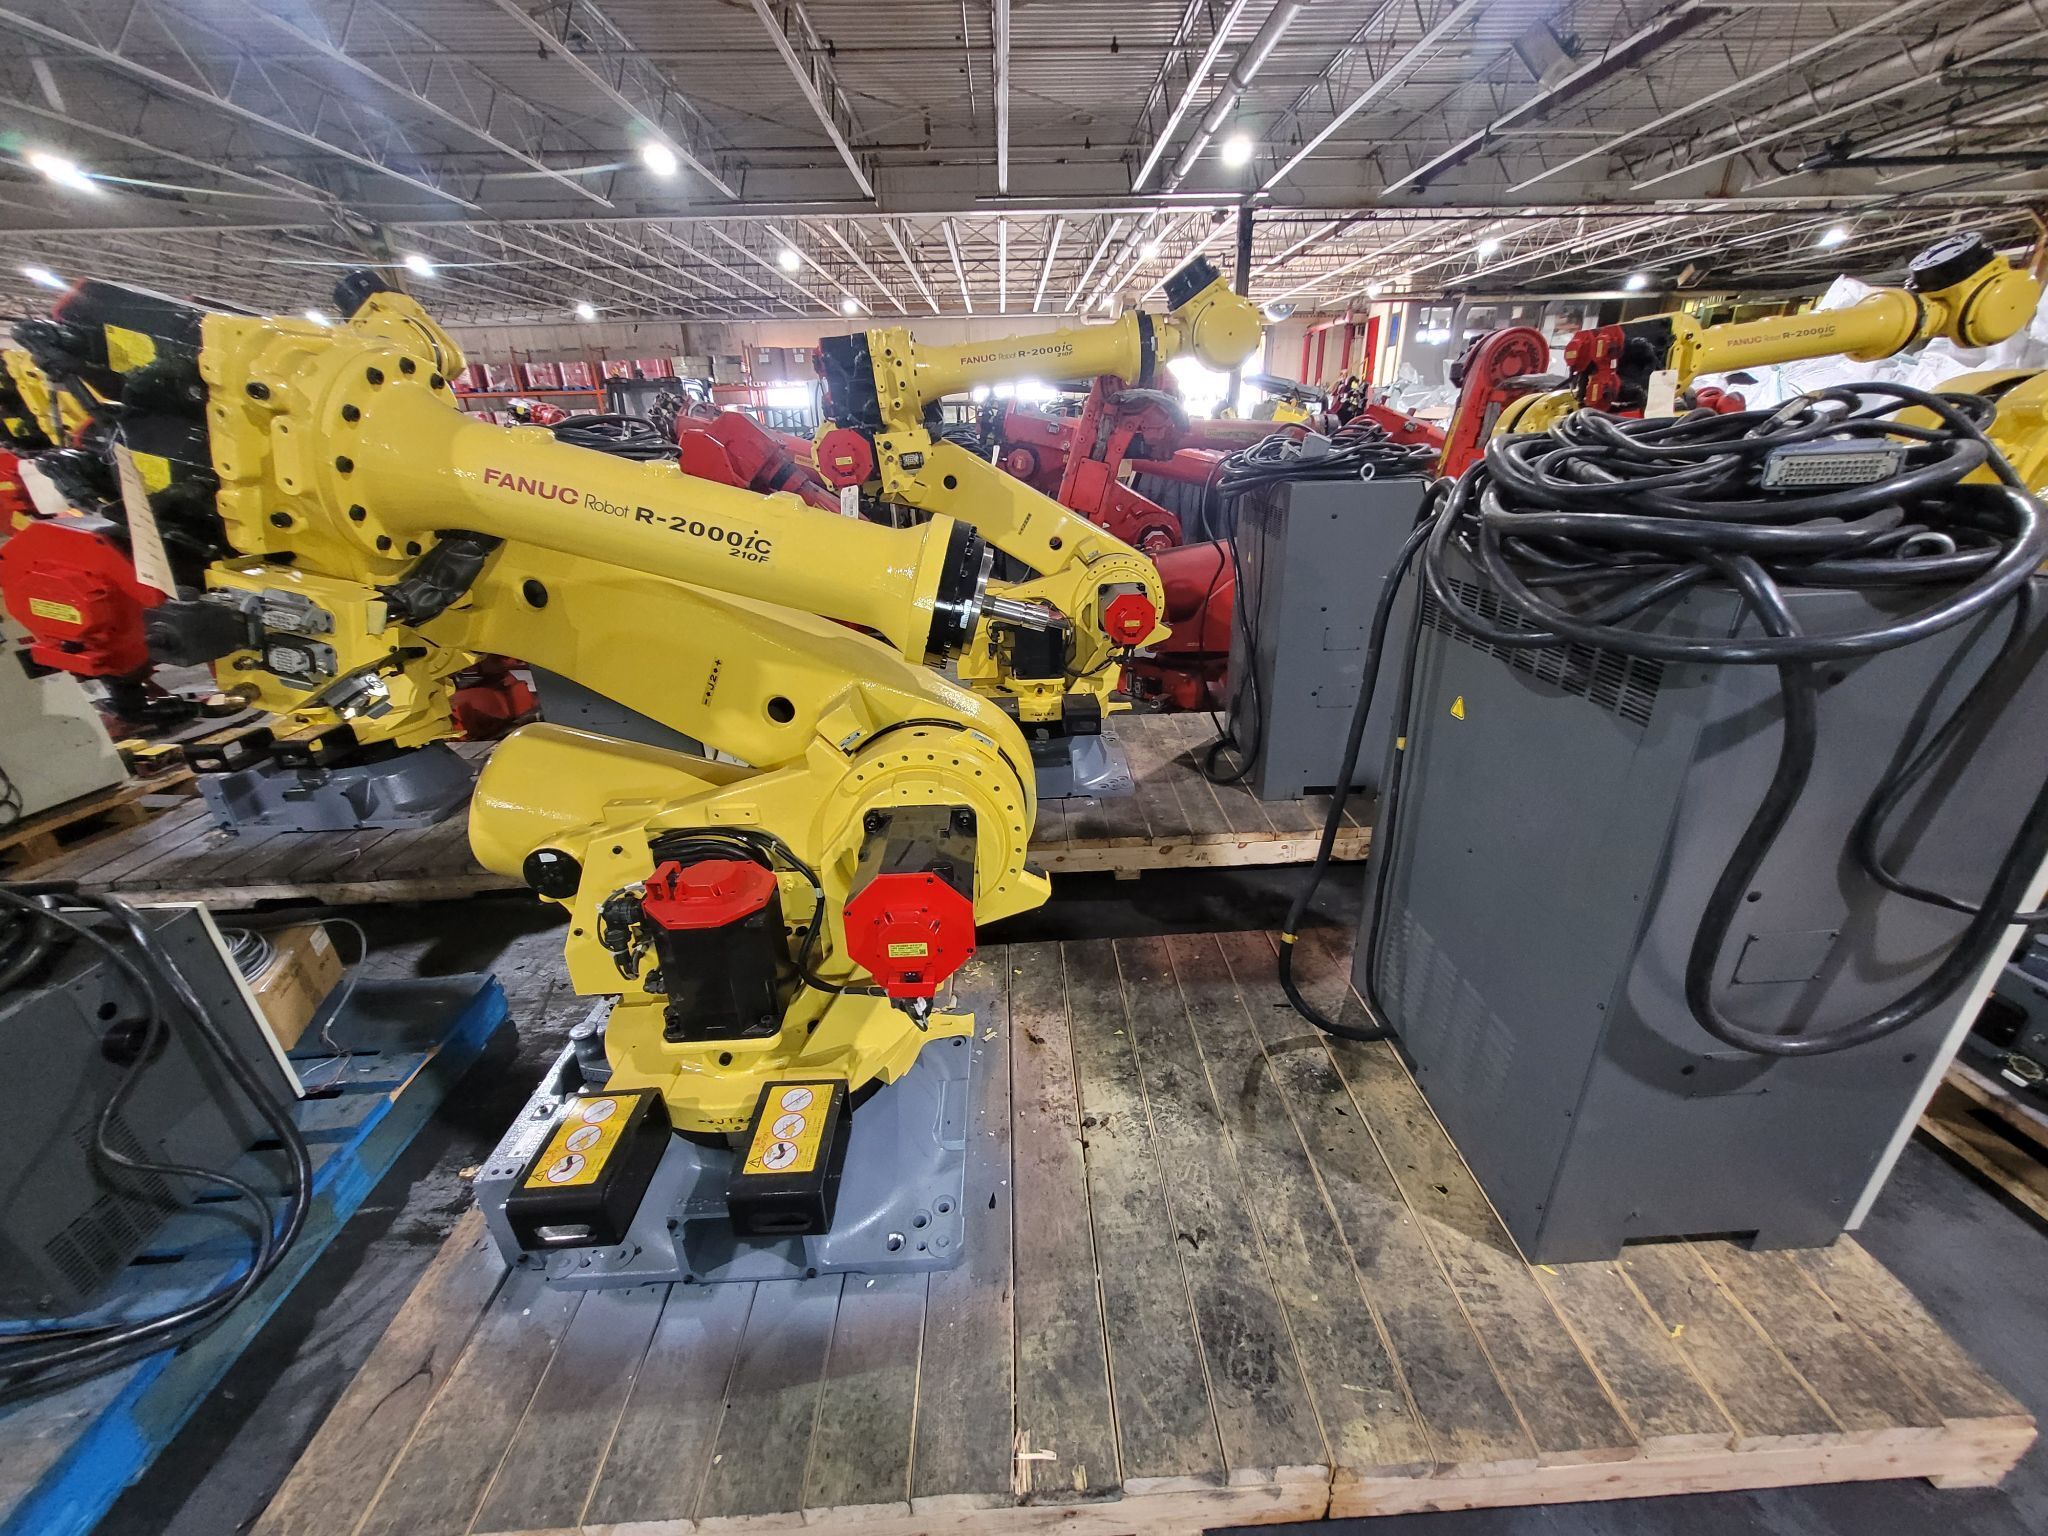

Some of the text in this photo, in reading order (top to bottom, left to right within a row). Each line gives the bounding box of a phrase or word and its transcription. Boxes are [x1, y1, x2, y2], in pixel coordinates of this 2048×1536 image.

[1727, 336, 1762, 347] FANUC
[960, 353, 996, 365] FANUC
[1018, 341, 1073, 358] R-2000iC
[483, 467, 772, 556] FANUC Robot R-2000iC
[729, 548, 771, 565] 210F
